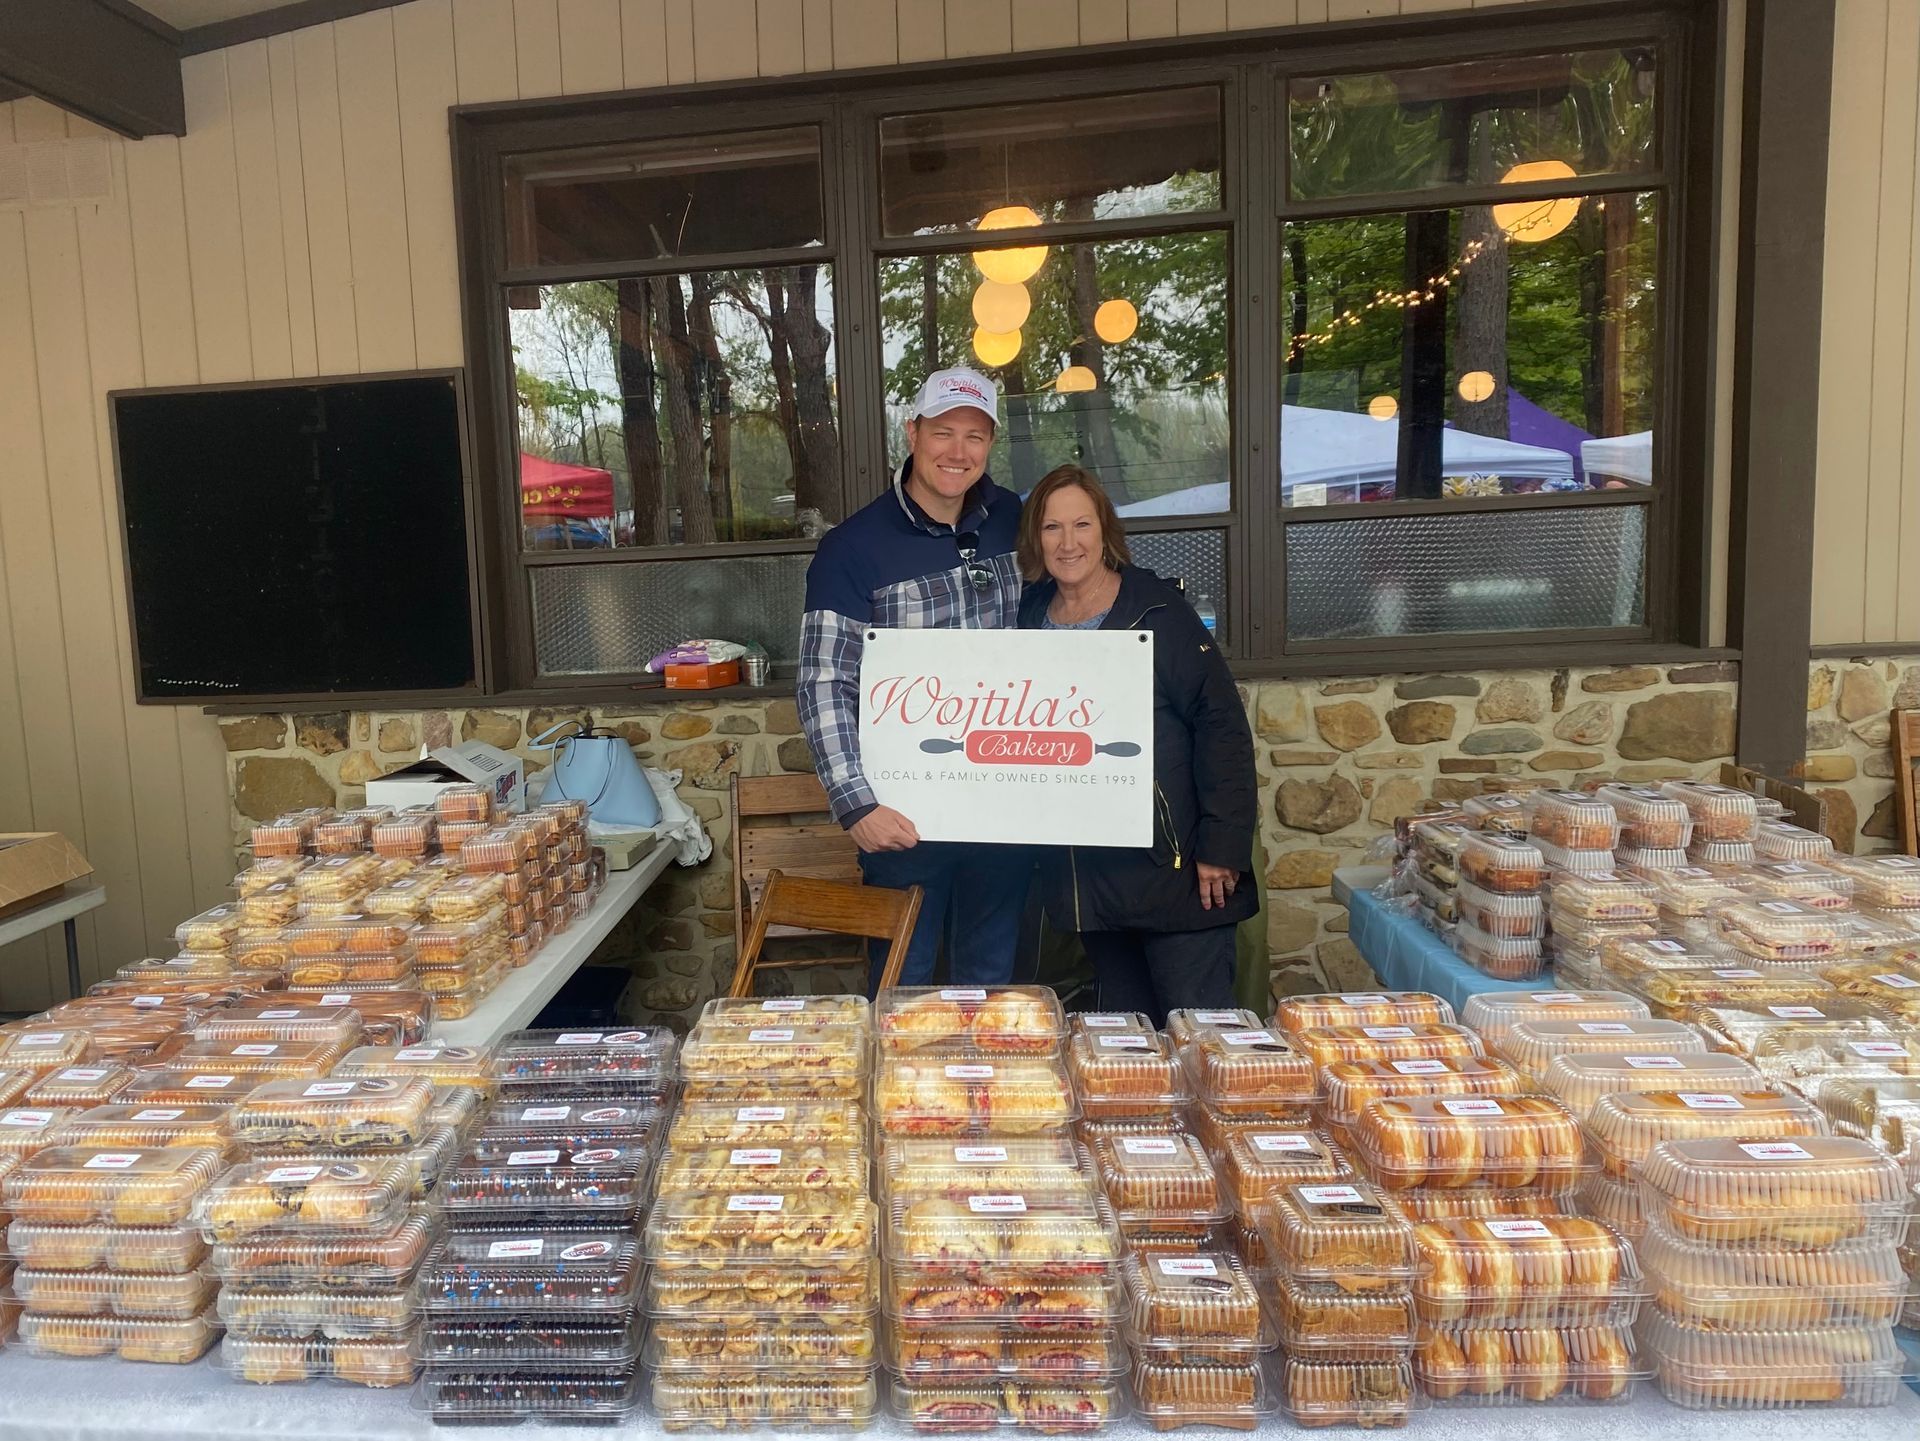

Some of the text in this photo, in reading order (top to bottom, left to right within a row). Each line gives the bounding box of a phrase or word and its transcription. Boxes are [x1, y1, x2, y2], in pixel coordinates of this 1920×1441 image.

[869, 675, 1105, 740] Wojtila's
[978, 732, 1081, 763] Bakery
[873, 769, 1136, 786] LOCAL & FAMILY OWNED SINCE 1993
